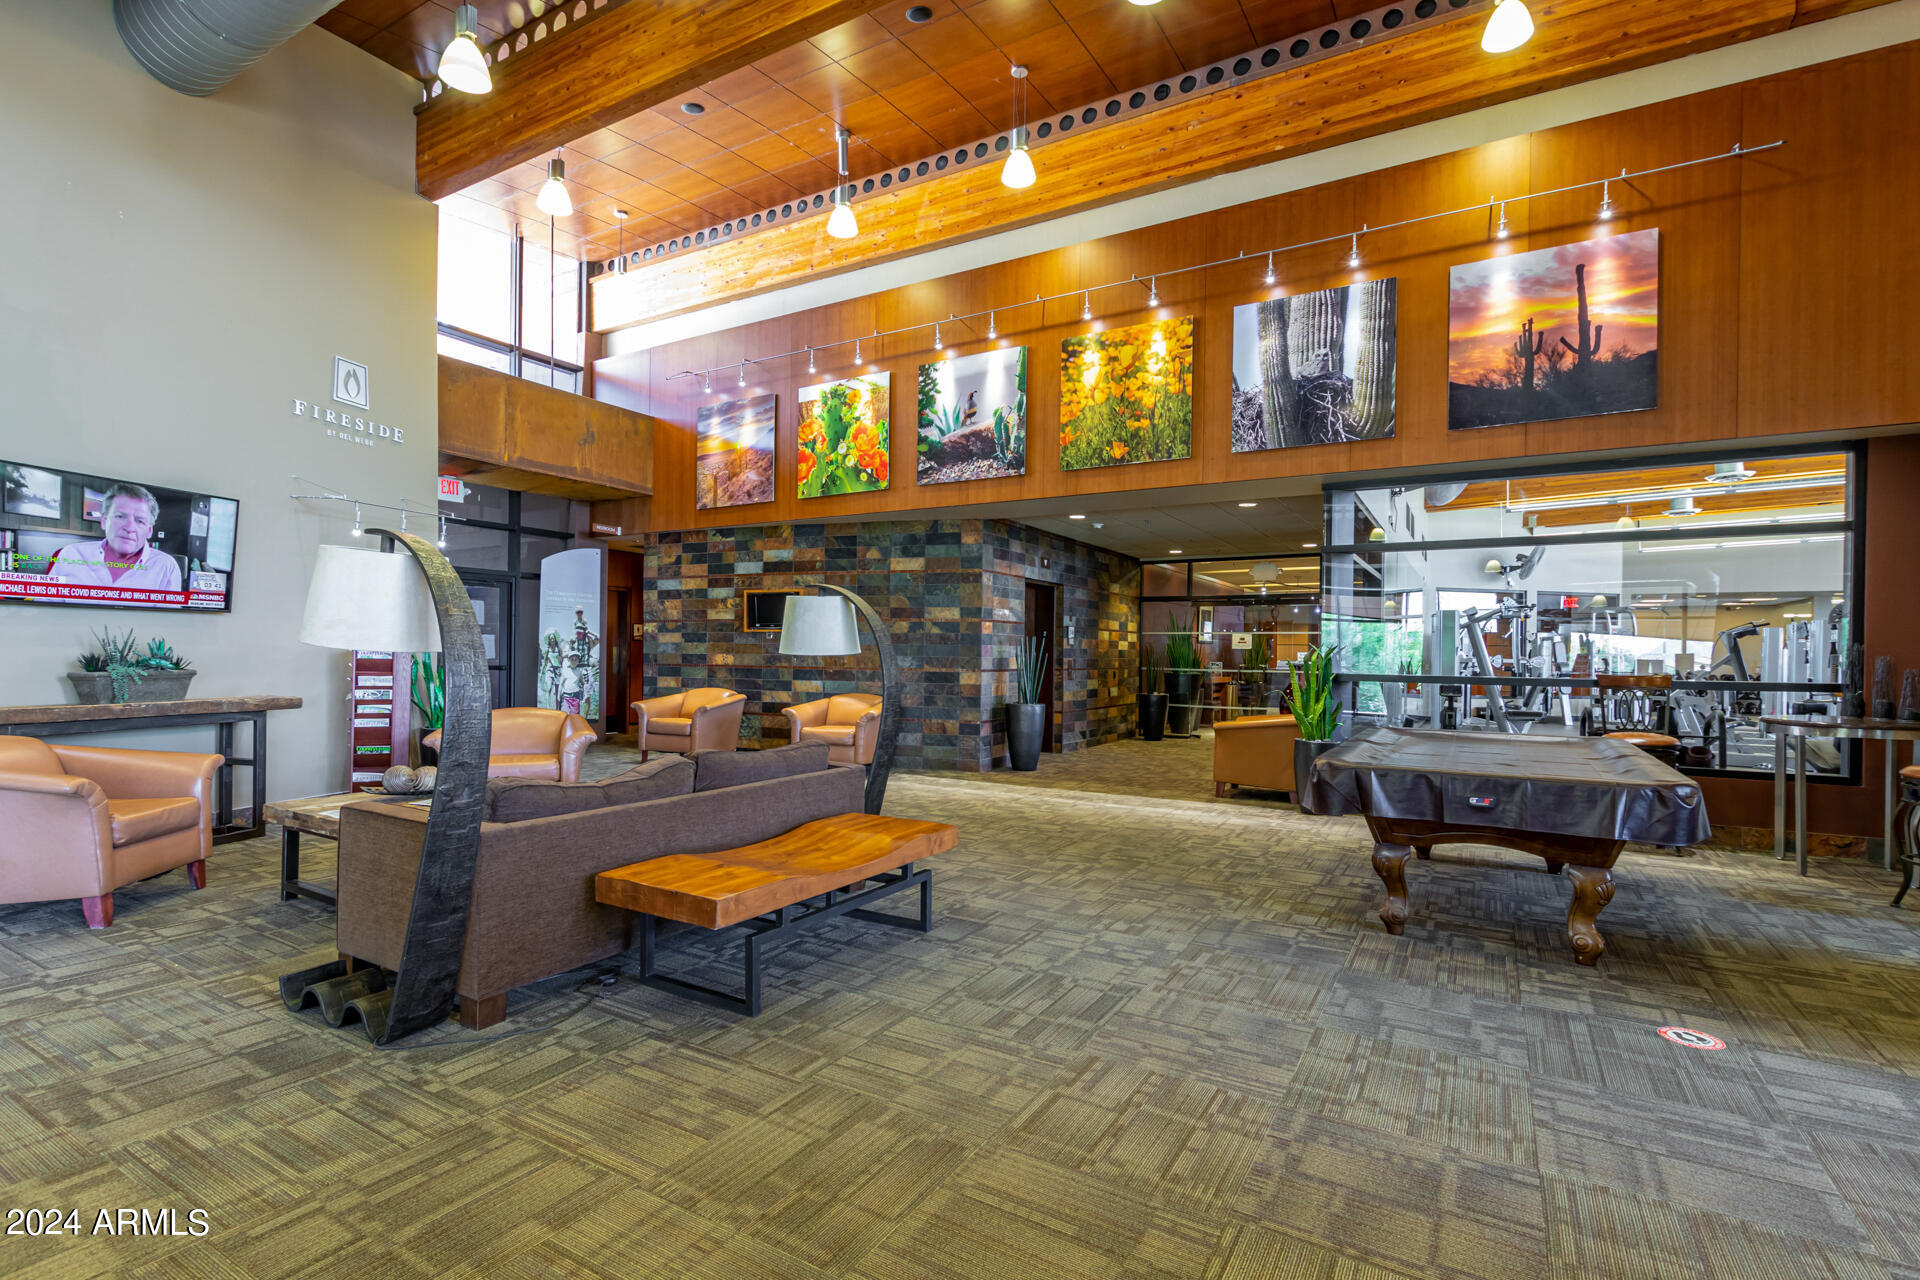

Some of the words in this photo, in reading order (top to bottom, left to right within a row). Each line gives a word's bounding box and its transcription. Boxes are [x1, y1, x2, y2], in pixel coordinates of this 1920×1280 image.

[293, 399, 405, 443] FIRESIDE
[440, 479, 460, 496] EXIT
[12, 553, 31, 561] ONE
[105, 561, 128, 569] STORY
[1, 572, 38, 581] BREAKING
[39, 575, 60, 583] NEWS
[26, 585, 46, 595] LEWIS
[47, 587, 57, 595] ON
[58, 587, 70, 596] THE
[70, 588, 90, 597] COVID
[90, 589, 120, 599] RESPONSE
[120, 591, 133, 599] AND
[133, 592, 149, 601] WHAT
[149, 593, 165, 601] WENT
[165, 594, 185, 602] WRONG
